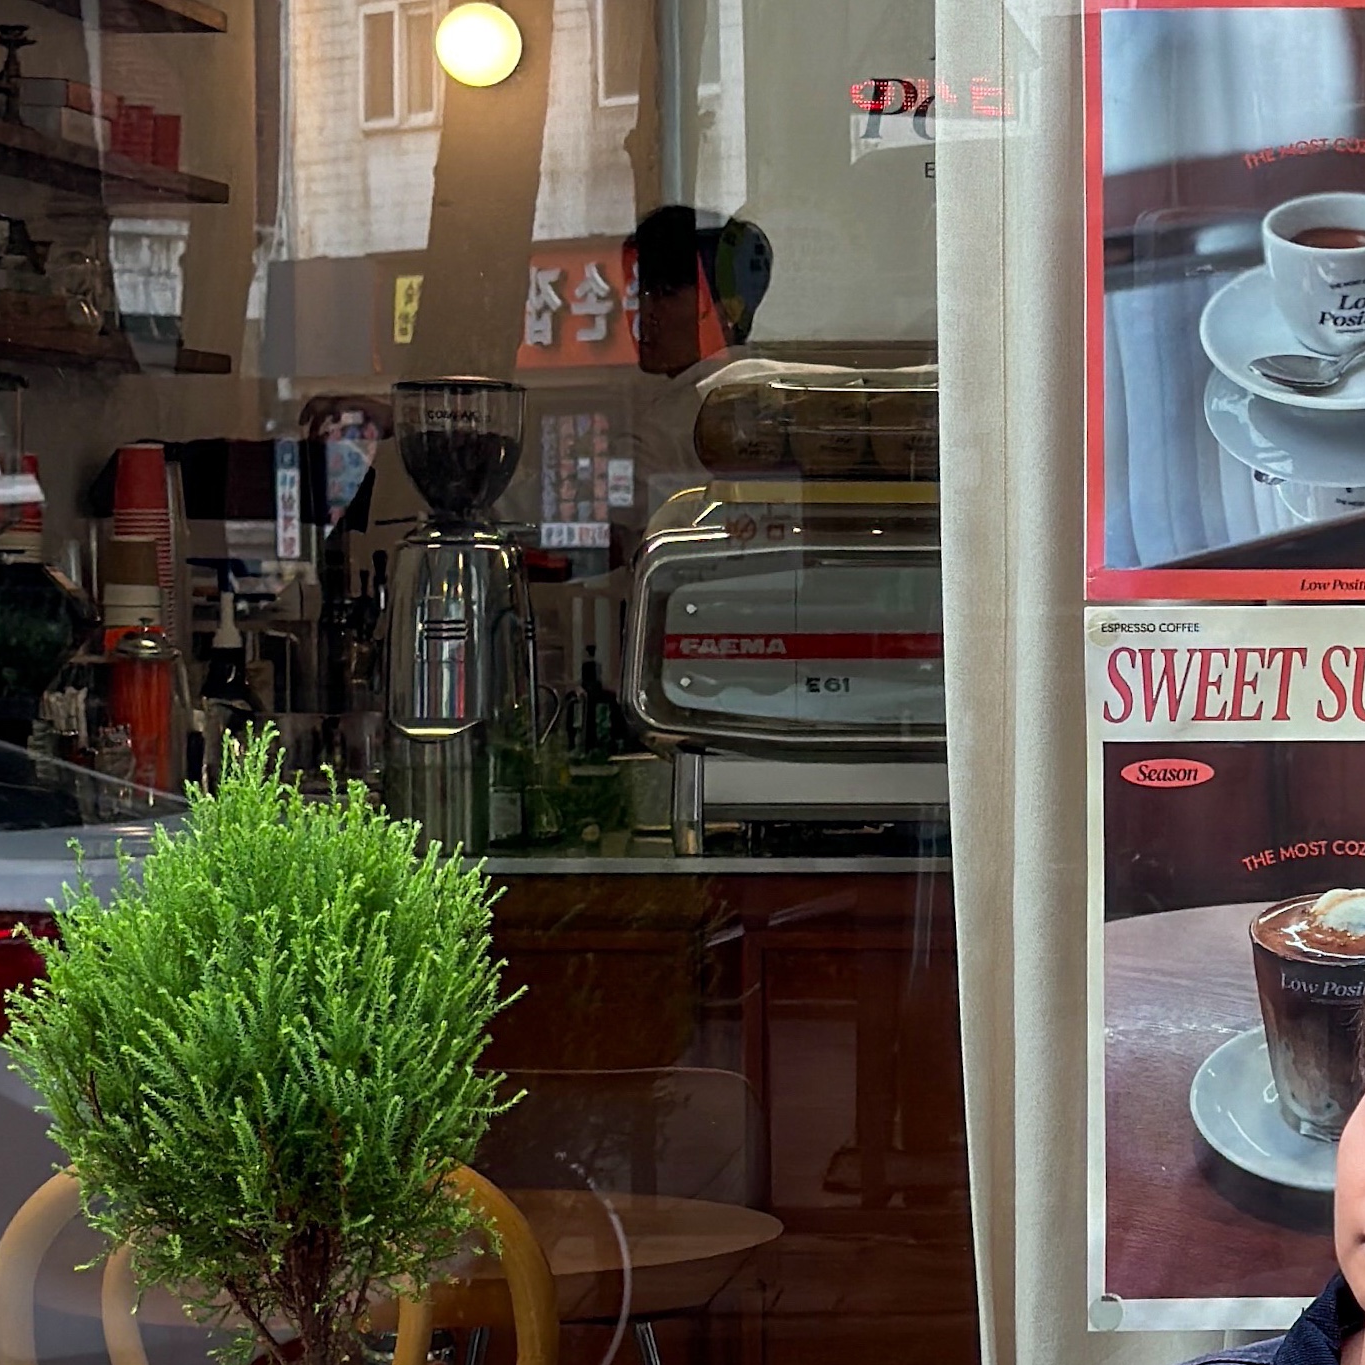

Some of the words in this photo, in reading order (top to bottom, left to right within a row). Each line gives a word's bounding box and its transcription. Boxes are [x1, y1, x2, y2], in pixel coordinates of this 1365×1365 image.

[1242, 147, 1276, 169] THE
[1278, 138, 1329, 156] MOST
[1300, 579, 1331, 592] Low
[1101, 623, 1156, 633] ESPRESSO
[1158, 623, 1200, 633] COFFEE
[679, 638, 787, 655] FAEMA
[1103, 647, 1307, 724] SWEET
[1135, 764, 1200, 784] Season
[1242, 848, 1276, 871] THE
[1279, 840, 1327, 860] MOST
[1281, 972, 1319, 993] Low
